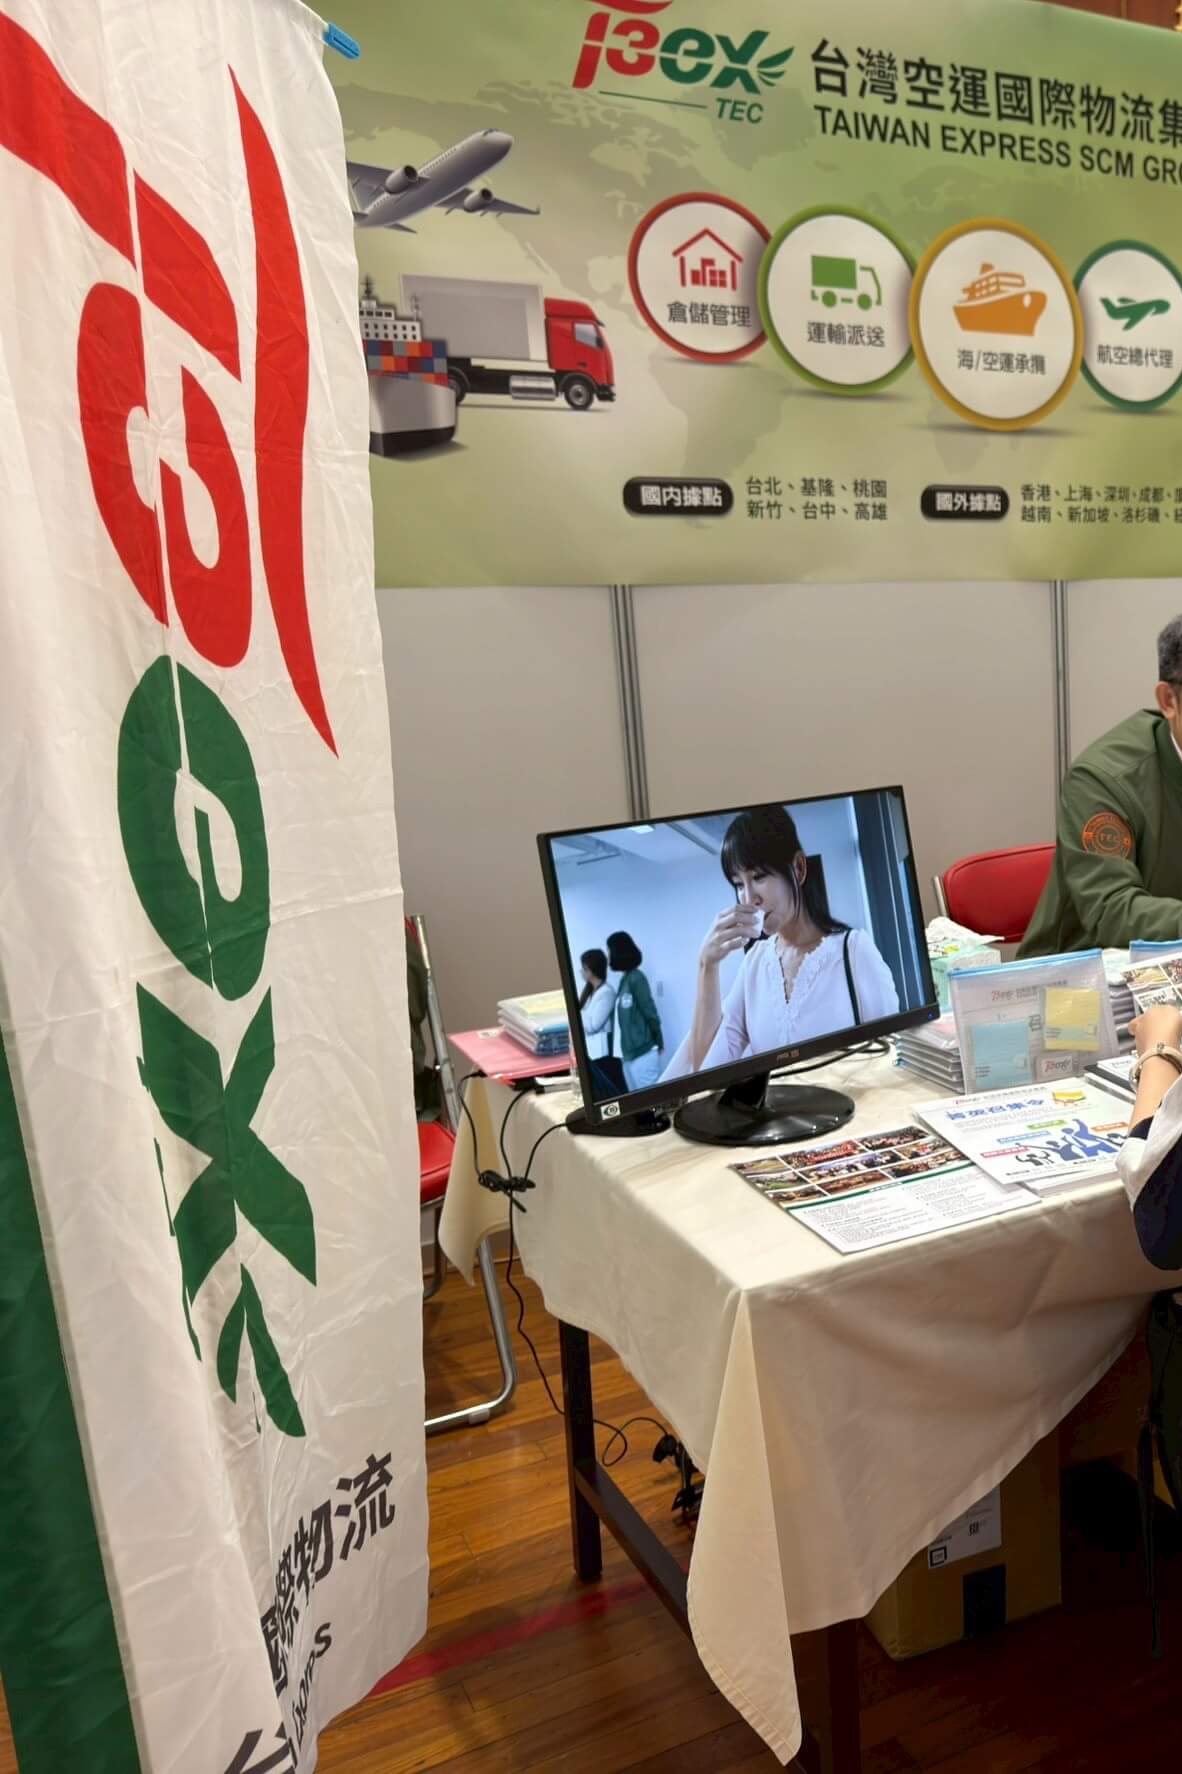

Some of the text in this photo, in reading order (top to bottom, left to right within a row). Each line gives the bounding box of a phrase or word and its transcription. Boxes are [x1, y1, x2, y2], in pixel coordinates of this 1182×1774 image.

[715, 98, 764, 124] TEC
[814, 105, 930, 148] TAIWAN
[942, 125, 1071, 167] EXPRESS
[1080, 145, 1133, 177] SCM
[667, 301, 751, 327] 倉儲管理
[807, 321, 886, 348] 運輸派送
[1097, 344, 1174, 369] 航空總代理
[640, 485, 723, 507] 國內據點
[746, 476, 887, 499] 台北、基隆、桃園
[747, 500, 888, 520] 新竹、台中、高雄
[936, 491, 1001, 513] 國外據點
